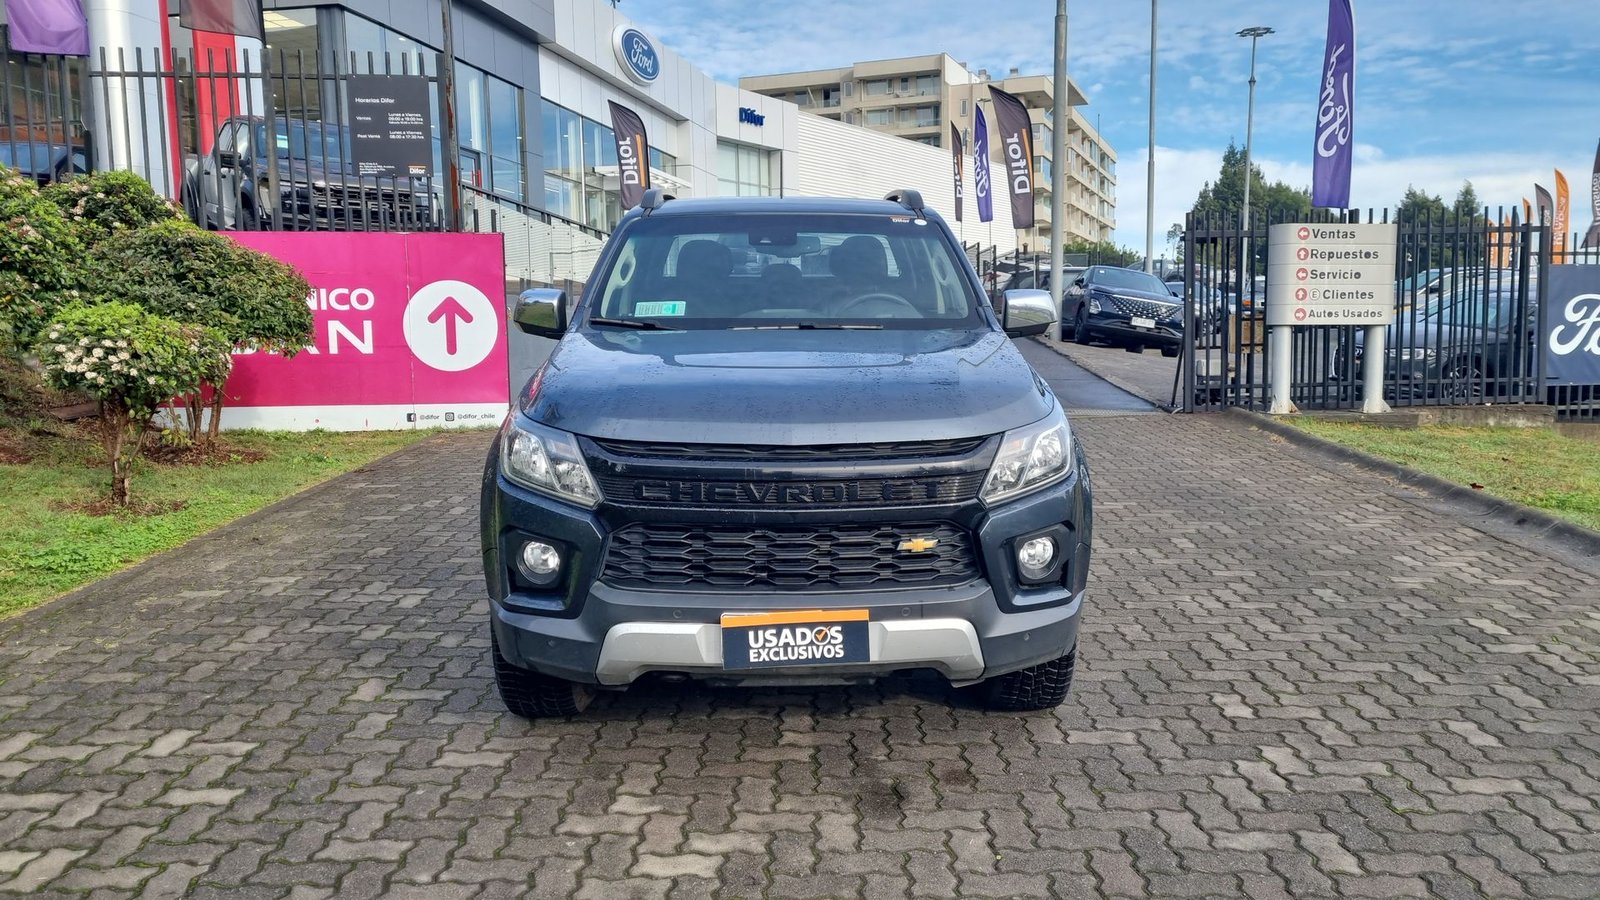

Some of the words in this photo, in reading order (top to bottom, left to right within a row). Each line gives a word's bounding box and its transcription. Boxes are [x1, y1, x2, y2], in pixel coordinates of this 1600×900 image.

[630, 37, 654, 73] Ford
[739, 106, 766, 126] Difor
[1312, 228, 1356, 239] Ventas
[1310, 249, 1379, 261] Repuestos
[1310, 269, 1361, 280] Servicio
[1323, 289, 1374, 300] Clientes
[1308, 309, 1340, 318] Autos
[1343, 309, 1383, 318] Usados
[457, 413, 496, 421] @difor_chile
[633, 479, 943, 502] CHEVROLET
[748, 625, 844, 649] USADOS
[749, 644, 845, 663] EXCLUSIVOS
